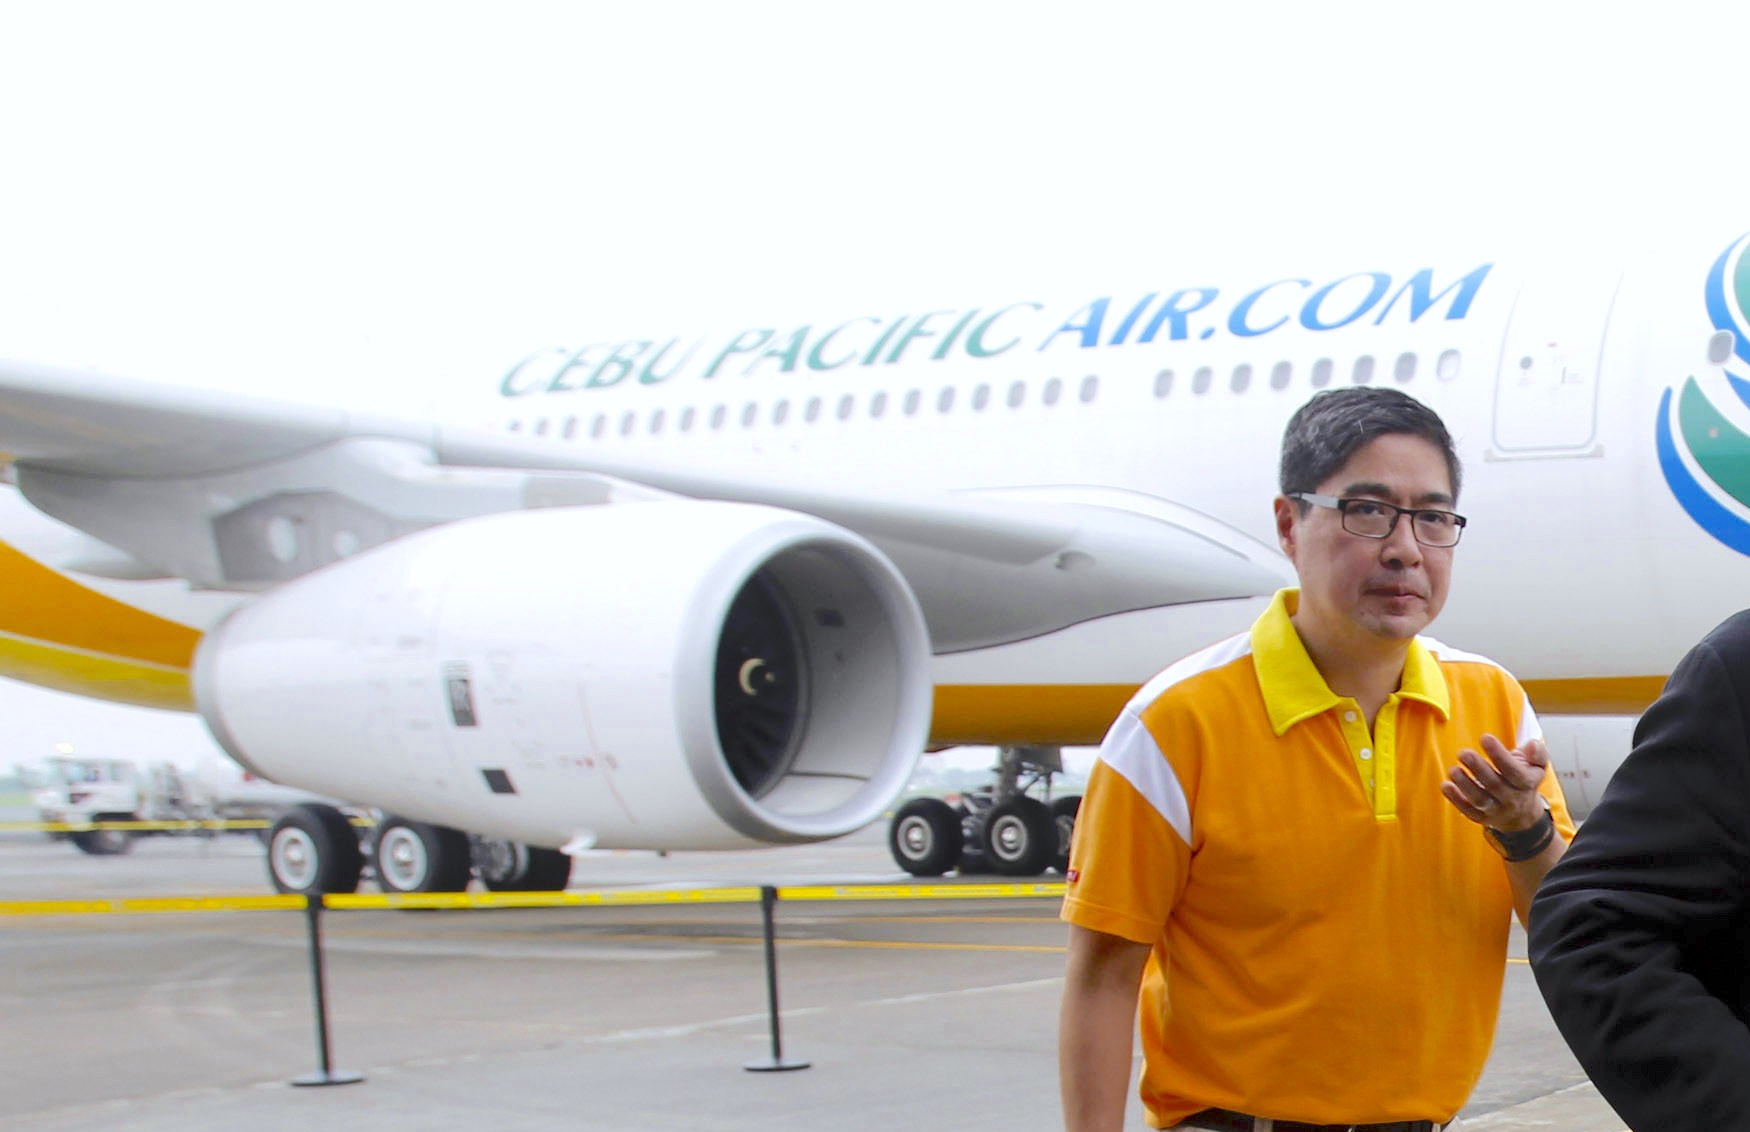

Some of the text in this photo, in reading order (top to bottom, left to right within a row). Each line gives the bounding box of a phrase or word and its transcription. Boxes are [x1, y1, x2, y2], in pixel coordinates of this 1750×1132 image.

[499, 262, 1495, 397] CEBU PACIFIC AIR.COM
